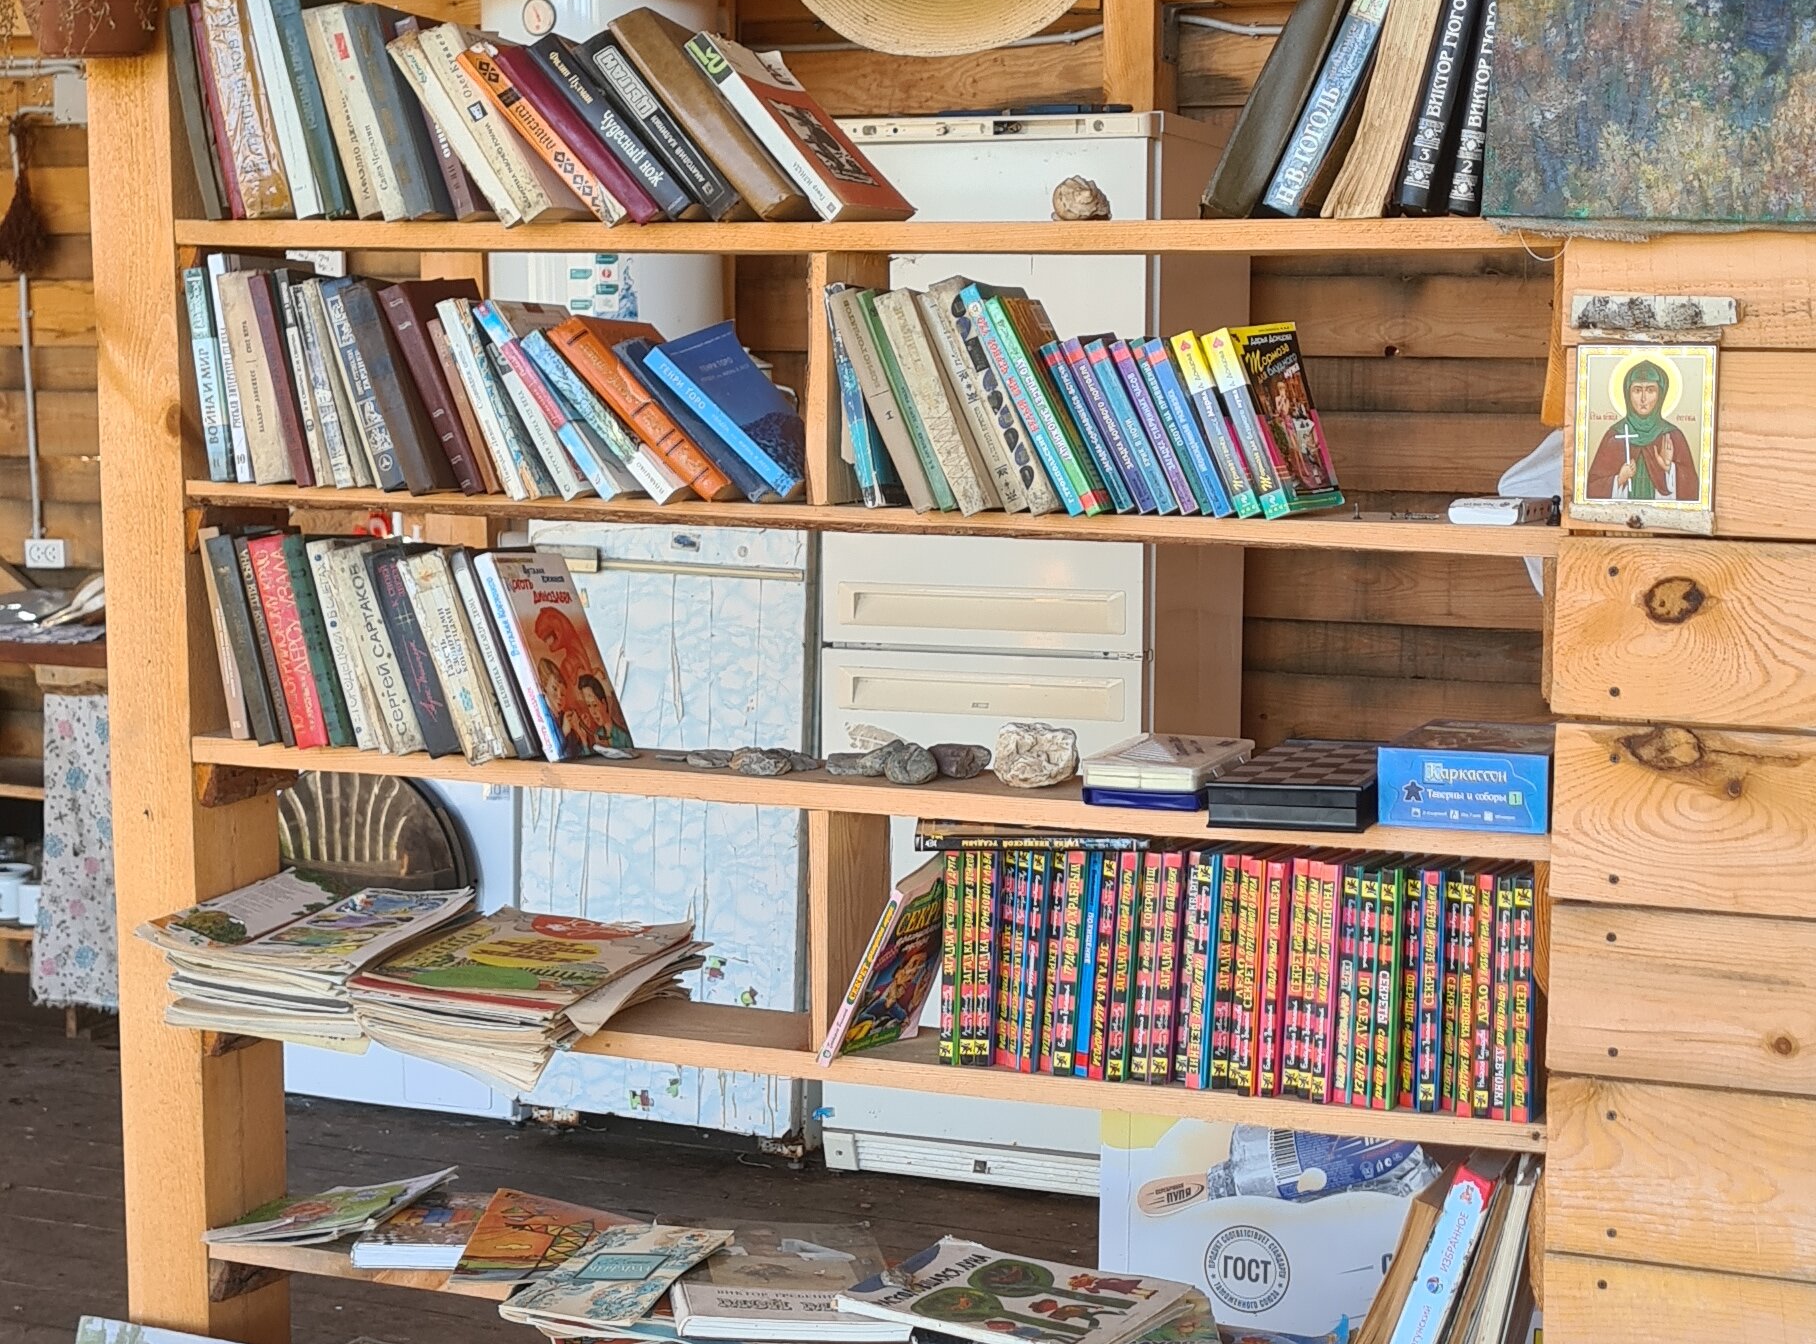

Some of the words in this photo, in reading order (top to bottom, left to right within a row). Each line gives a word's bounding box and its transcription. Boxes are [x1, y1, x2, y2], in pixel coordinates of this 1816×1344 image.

[427, 26, 460, 73] Куваев
[453, 72, 475, 99] Олег
[565, 73, 595, 106] Пулман
[599, 49, 655, 116] ЦЫГАН
[1426, 50, 1456, 118] ВИКТОР
[1466, 58, 1493, 128] ВИКТОР
[594, 108, 647, 166] Чудесный
[637, 157, 667, 188] нож
[649, 114, 678, 148] КАЛИНИН
[674, 145, 705, 184] АНАТОЛИЙ
[1418, 147, 1431, 161] 3
[1460, 159, 1473, 173] 2
[374, 164, 388, 190] Саша
[197, 347, 212, 380] МИР
[1185, 352, 1201, 381] Донцова
[1216, 350, 1232, 379] Донцова
[1245, 344, 1289, 373] Тормоза
[202, 382, 213, 392] И
[658, 362, 684, 389] ГЕНРИ
[684, 386, 707, 410] ТОРО
[1056, 364, 1076, 394] ВСТРЕЧИ
[1078, 364, 1101, 401] ПОРТФЕЛЯ
[1126, 371, 1143, 397] ЧАСОВ
[1140, 360, 1168, 410] ПРИВИДЕНИЙ
[1231, 389, 1243, 408] мужа
[202, 394, 219, 444] ВОЙНА
[1015, 356, 1029, 375] КТО
[1024, 374, 1045, 407] СПАСЕТ
[1039, 405, 1072, 462] ЗАЛОЖНИЦУ?
[1096, 400, 1121, 440] БОРДОВОГО
[1137, 396, 1162, 439] СТАРИННЫХ
[1162, 410, 1172, 421] НА
[1198, 390, 1215, 417] Марпл
[1124, 417, 1139, 439] НОЧИ
[1134, 439, 1142, 447] В
[1167, 421, 1184, 447] ОХОТА
[1094, 443, 1113, 472] ЗАГАДКА
[1115, 440, 1134, 469] ЗАГАДКА
[1137, 447, 1151, 467] КРИК
[1156, 439, 1176, 471] ЗАГАДКА
[239, 548, 254, 580] СЫНА
[254, 548, 275, 590] КРАЮ
[269, 547, 294, 608] УЗАЛА
[247, 582, 260, 607] ДЛЯ
[345, 562, 386, 658] САРТАКОВ
[283, 618, 310, 676] ДЕРСУ
[1424, 761, 1507, 783] Каркассон
[1427, 789, 1464, 801] Таверны
[1475, 792, 1507, 802] соборы
[983, 852, 992, 876] ЛЬВА
[980, 878, 991, 934] БРОНЗОВОГО
[1069, 864, 1080, 917] ХРАБРЫМ
[1143, 867, 1156, 926] СОКРОВИЩ
[1188, 867, 1197, 911] КВАРТЕТ
[1269, 880, 1280, 929] КИЛЛЕРА
[1309, 878, 1318, 911] ДАМЫ
[1066, 921, 1077, 940] БЫТЬ
[1321, 882, 1332, 939] ШПИОНА
[1307, 914, 1317, 949] ЧЕРНОЙ
[1425, 929, 1436, 962] ЗЕЛЕНОЙ
[944, 935, 955, 975] ЗАГАДКА
[963, 940, 973, 985] ЗАГАДКА
[979, 939, 989, 985] ЗАГАДКА
[1063, 943, 1074, 976] ТРУДНО
[1098, 943, 1109, 1000] ЗАГАДКА
[1116, 949, 1127, 992] ЗАГАДКА
[1160, 946, 1171, 990] ЗАГАДКА
[1220, 944, 1230, 991] ЗАГАДКА
[1291, 952, 1302, 992] СЕКРЕТ
[1244, 962, 1254, 1008] СЕКРЕТ
[1304, 952, 1315, 999] СЕКРЕТ
[1361, 975, 1370, 994] ПО
[1424, 963, 1435, 1006] СЕКРЕТ
[1377, 970, 1390, 1023] СЕКРЕТЫ
[1406, 974, 1416, 1022] ОПЕРАЦИЯ
[1446, 976, 1456, 1018] СЕКРЕТ
[1460, 973, 1472, 1037] МАСКИРОВКА
[1478, 985, 1489, 1023] ДЕЛО
[1515, 985, 1527, 1026] СЕКРЕТ
[1358, 998, 1369, 1038] СЛЕДУ
[1189, 1023, 1201, 1073] ВЕЗЕНИЕ
[1353, 1040, 1367, 1095] ЧЕТЫРЕХ
[1493, 1048, 1504, 1106] ДЕВЧОНКА
[1167, 1188, 1191, 1204] ПУЛЯ
[1208, 1240, 1223, 1268] ПРОДУКТ
[1221, 1229, 1269, 1246] СООТВЕТСТВУЕТ
[1438, 1211, 1469, 1272] ИЗБРАННОЕ
[1223, 1255, 1271, 1284] ГОСТ
[1213, 1281, 1258, 1308] ТАМОЖЕННОГО
[1259, 1290, 1280, 1308] СОЮЗА
